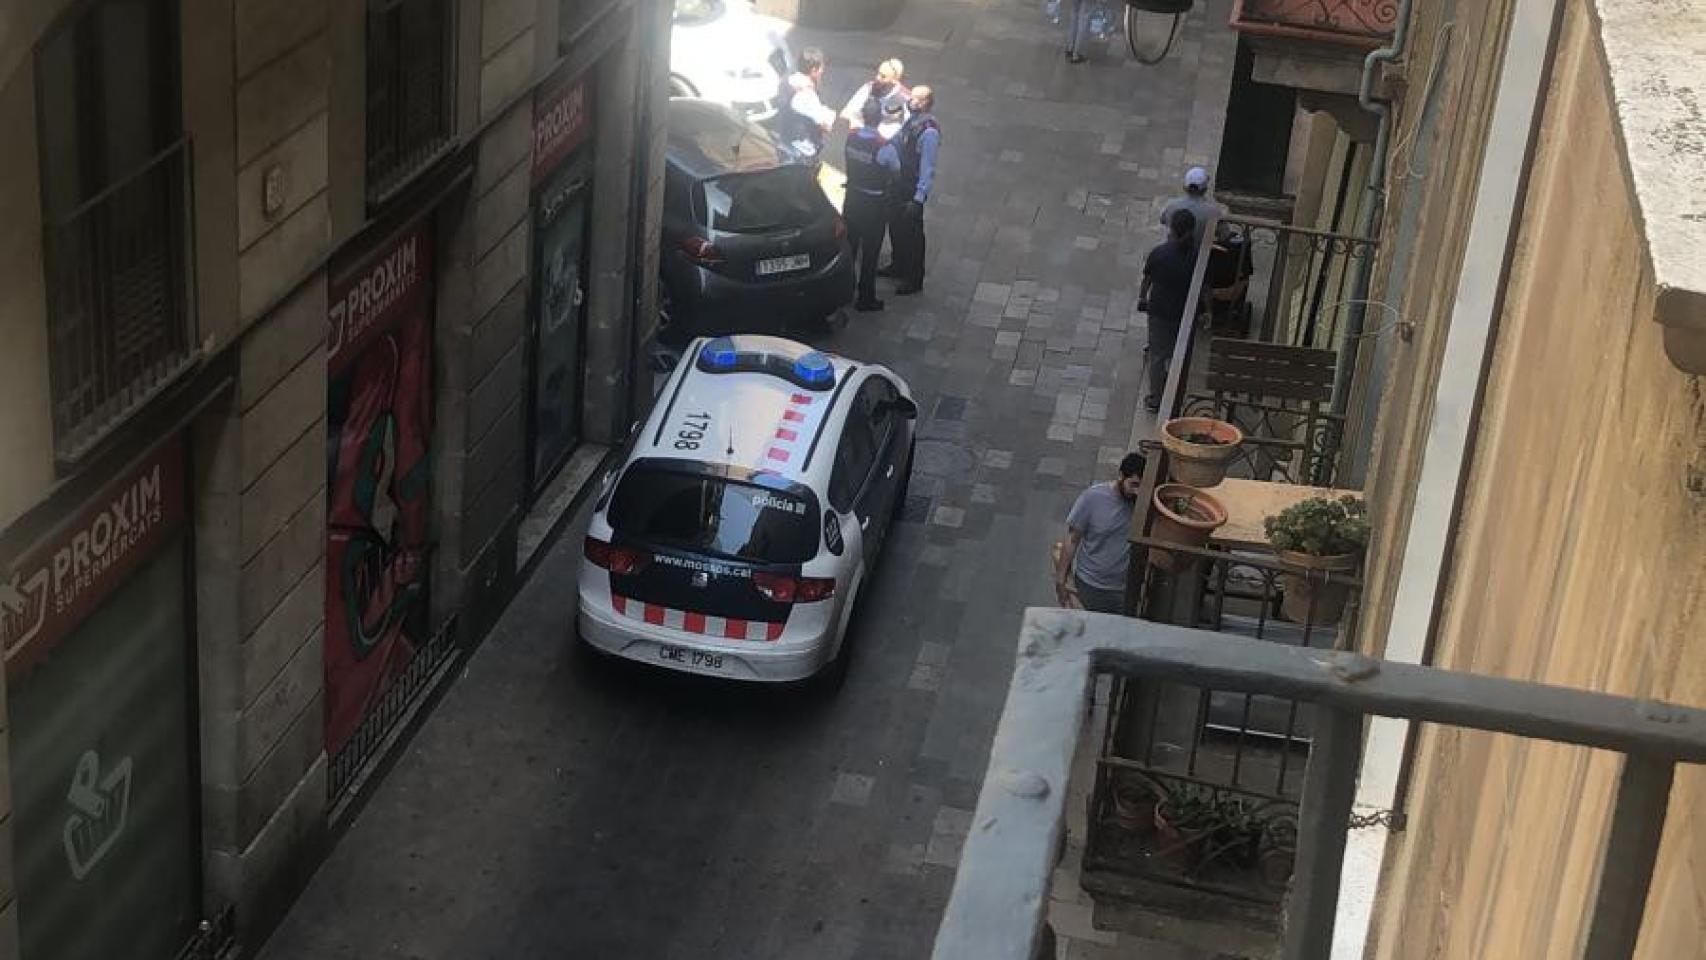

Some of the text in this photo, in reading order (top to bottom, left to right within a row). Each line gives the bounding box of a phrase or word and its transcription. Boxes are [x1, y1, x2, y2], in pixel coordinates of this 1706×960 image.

[537, 83, 584, 155] PROXIM
[348, 236, 417, 325] PROXIM
[674, 411, 711, 450] 1798
[54, 463, 161, 594] PROXIM
[56, 506, 161, 614] SUPERMERCATS
[691, 650, 723, 668] 1798
